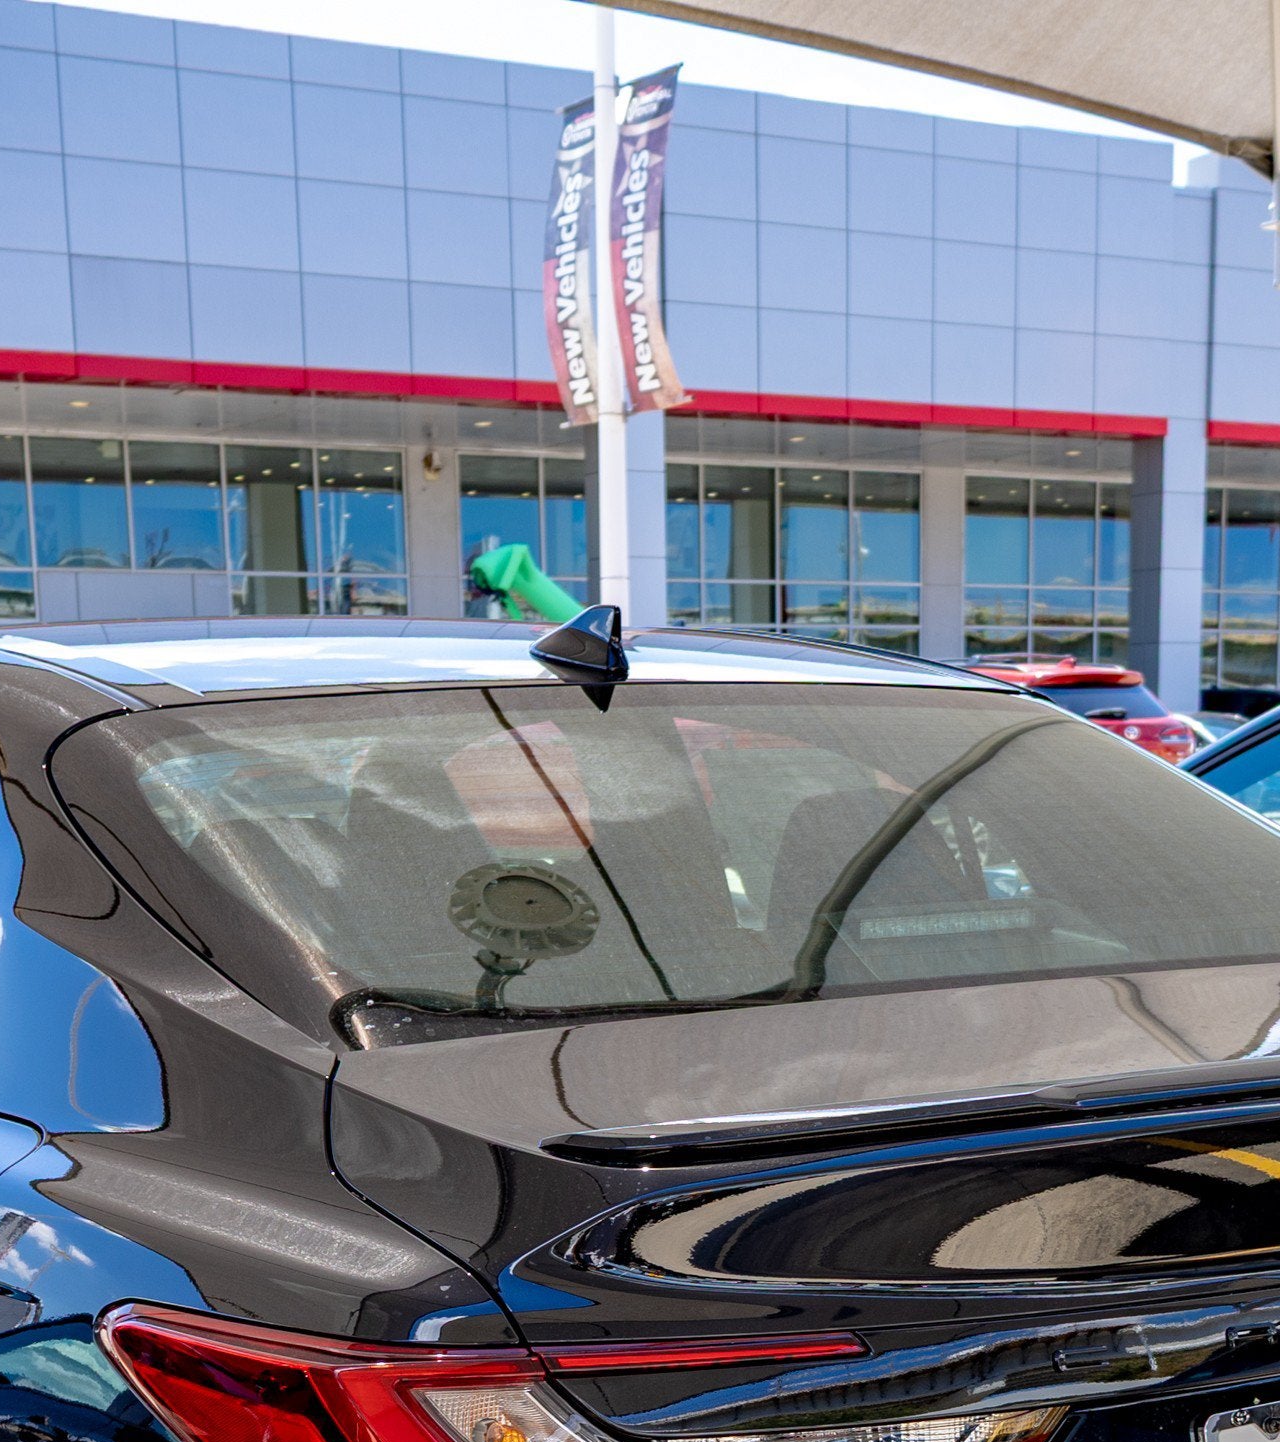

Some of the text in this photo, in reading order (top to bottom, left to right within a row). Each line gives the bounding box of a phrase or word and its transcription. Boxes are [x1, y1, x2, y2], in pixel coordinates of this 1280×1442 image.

[554, 171, 584, 324] Vehicles
[622, 148, 650, 306] Vehicles
[563, 328, 595, 406] New
[629, 312, 662, 393] New
